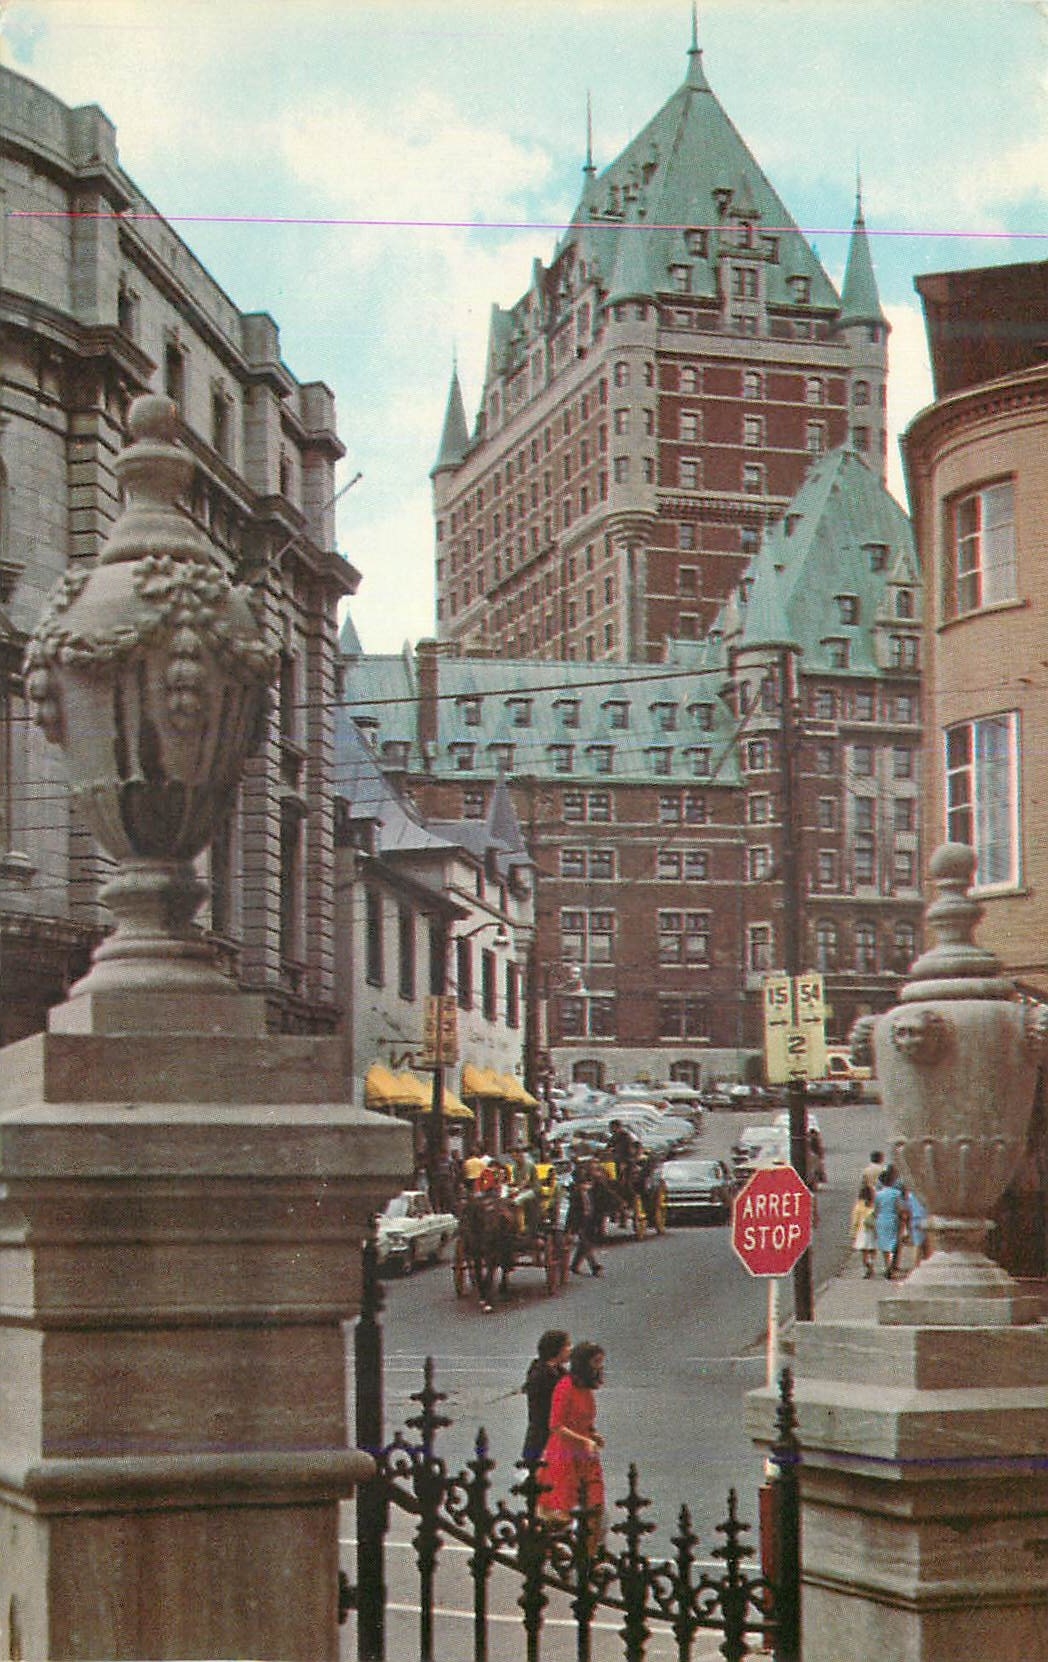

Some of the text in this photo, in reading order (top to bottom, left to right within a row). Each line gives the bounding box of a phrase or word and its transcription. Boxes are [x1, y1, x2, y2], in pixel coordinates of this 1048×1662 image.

[768, 986, 789, 1005] 15
[788, 1035, 806, 1054] 2
[743, 1193, 803, 1219] ARRET
[743, 1224, 801, 1250] STOP
